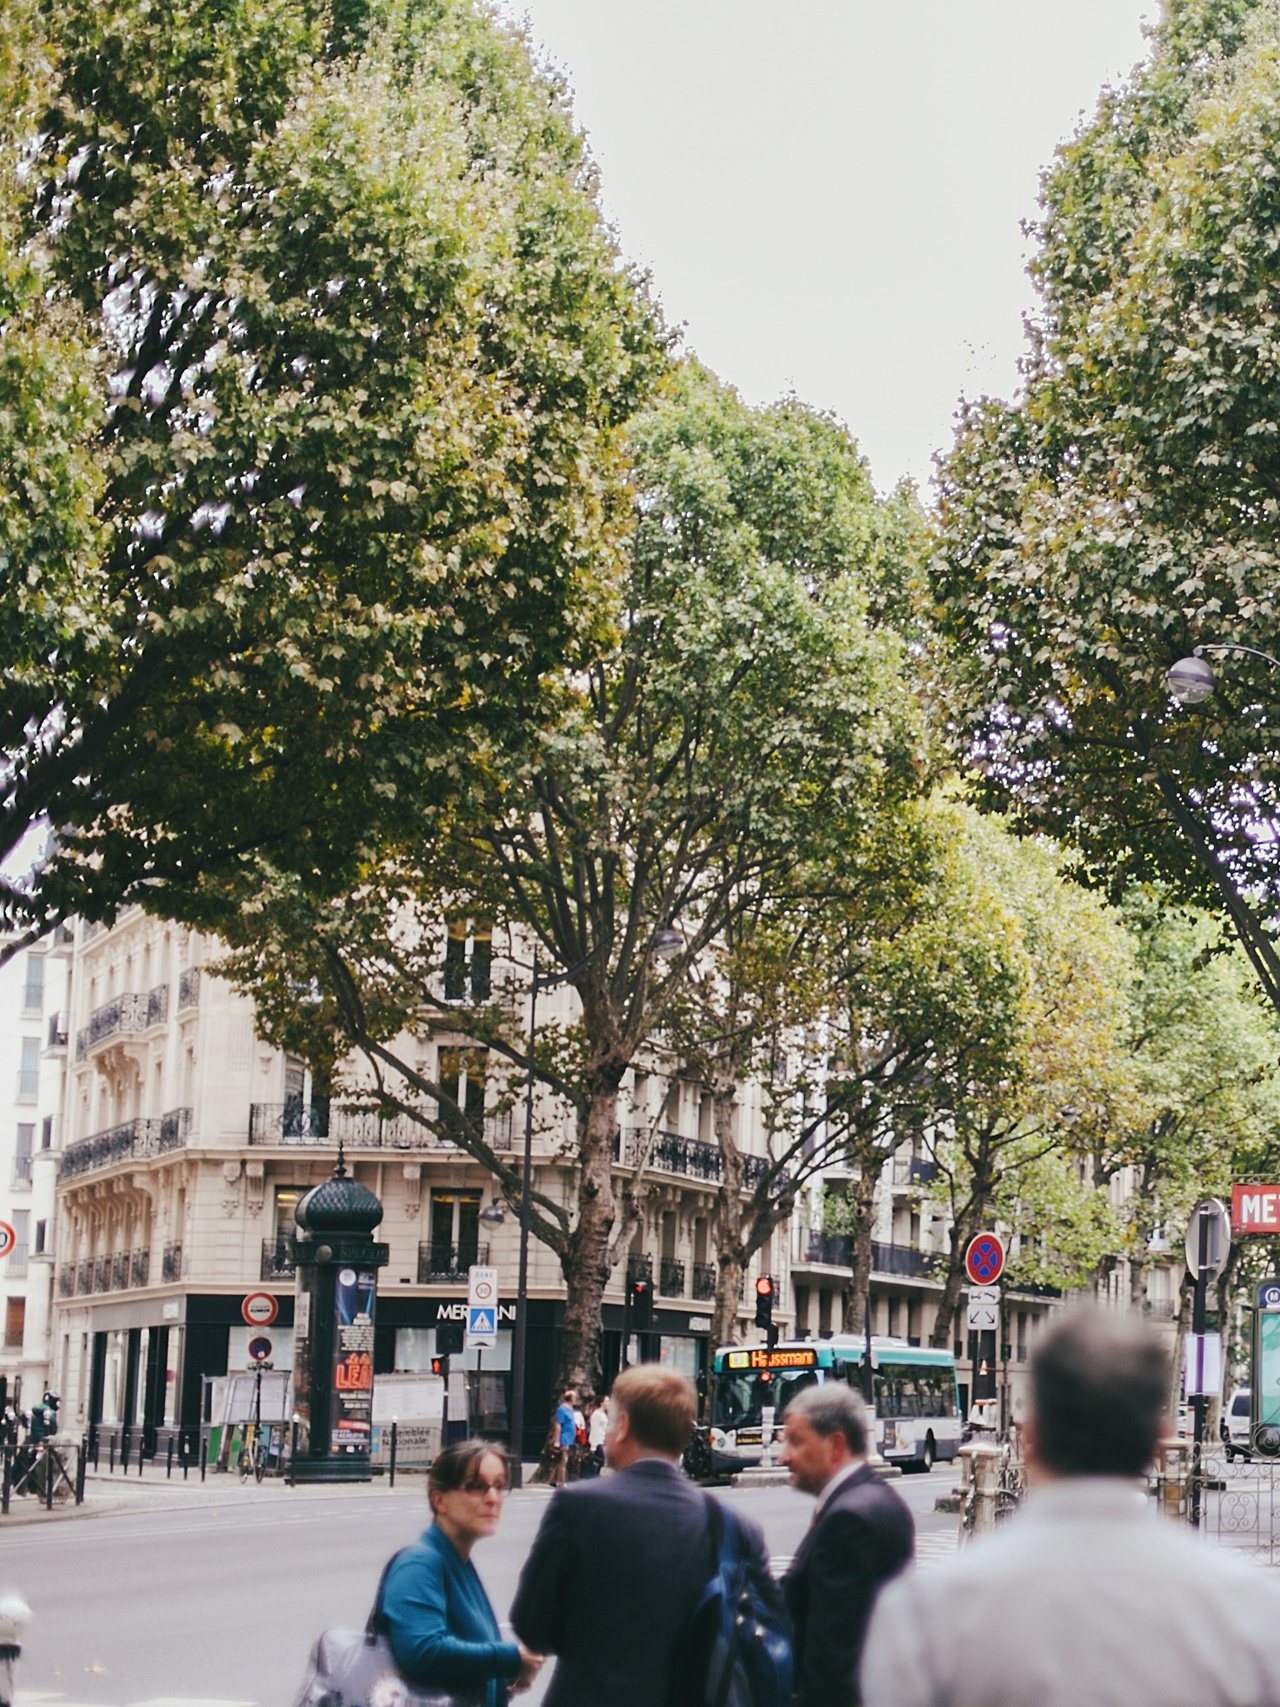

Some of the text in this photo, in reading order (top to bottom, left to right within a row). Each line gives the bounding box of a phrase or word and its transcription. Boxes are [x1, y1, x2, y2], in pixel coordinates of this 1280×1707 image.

[436, 1304, 516, 1320] MERNI
[381, 1427, 431, 1438] Aemblée
[382, 1437, 427, 1446] Nionale
